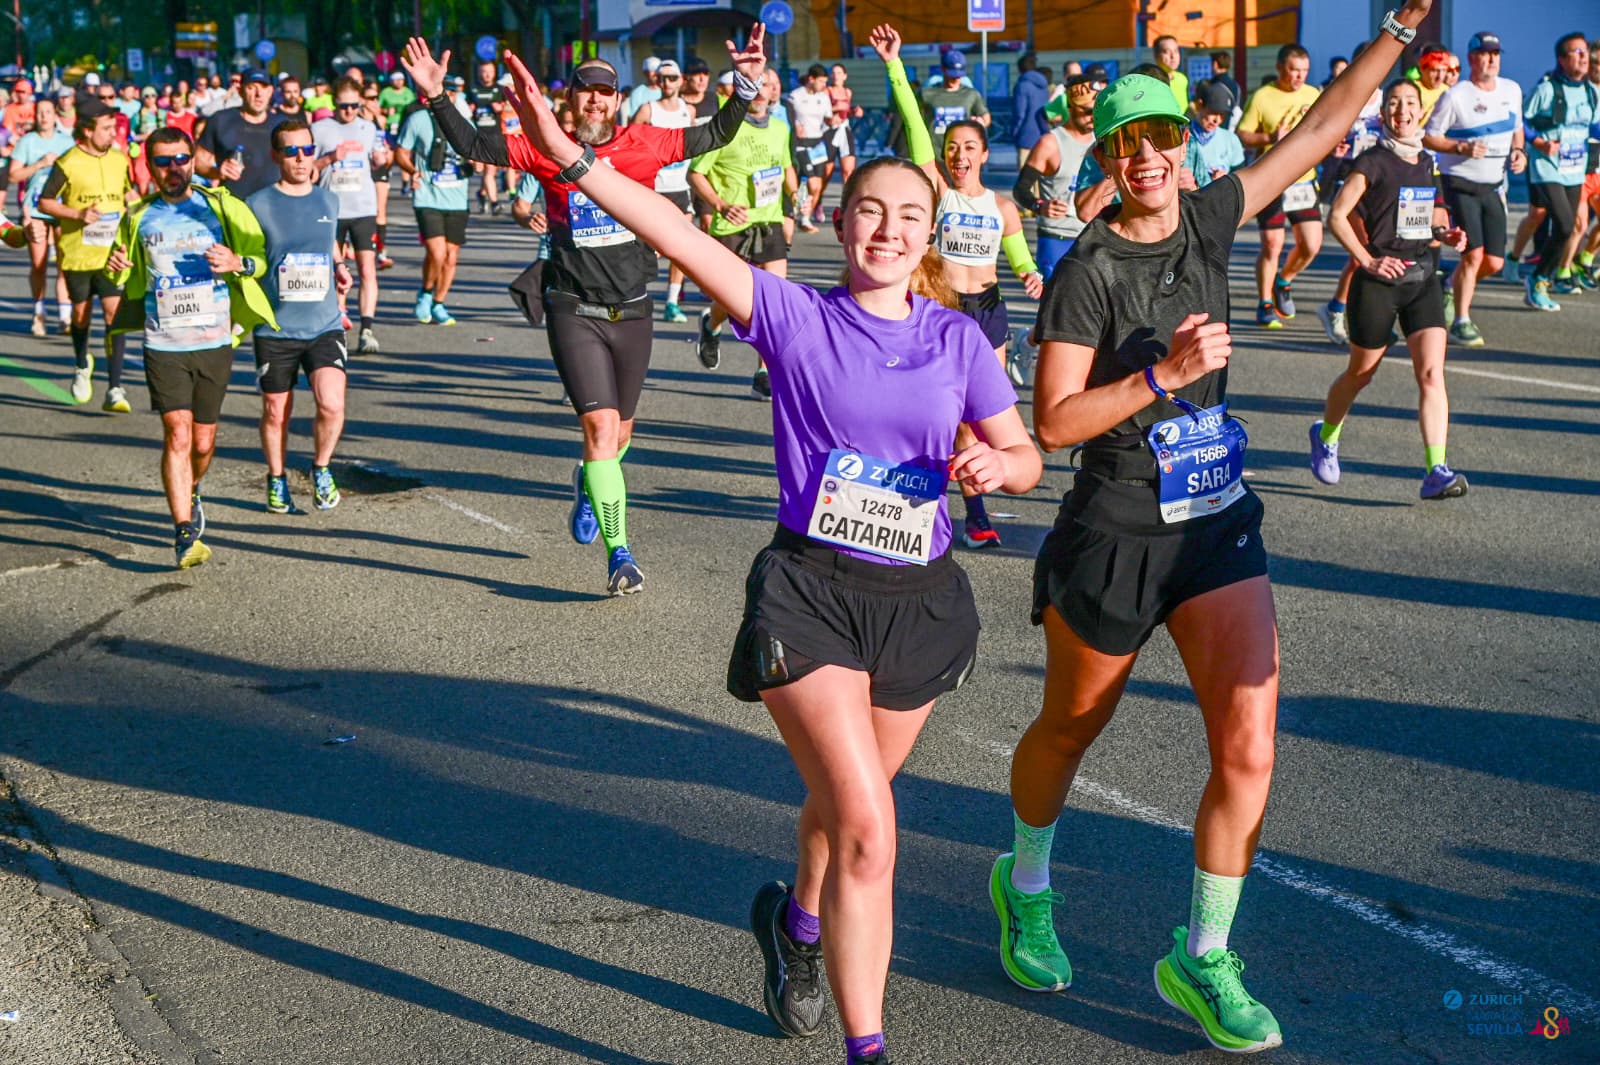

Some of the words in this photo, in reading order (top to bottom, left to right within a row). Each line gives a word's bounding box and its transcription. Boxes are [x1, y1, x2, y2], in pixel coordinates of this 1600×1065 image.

[946, 241, 991, 256] VANESSA
[171, 302, 200, 315] JOAN
[869, 465, 929, 491] ZURICH
[1186, 462, 1231, 495] SARA
[860, 498, 903, 521] 12478
[818, 512, 922, 556] CATARINA
